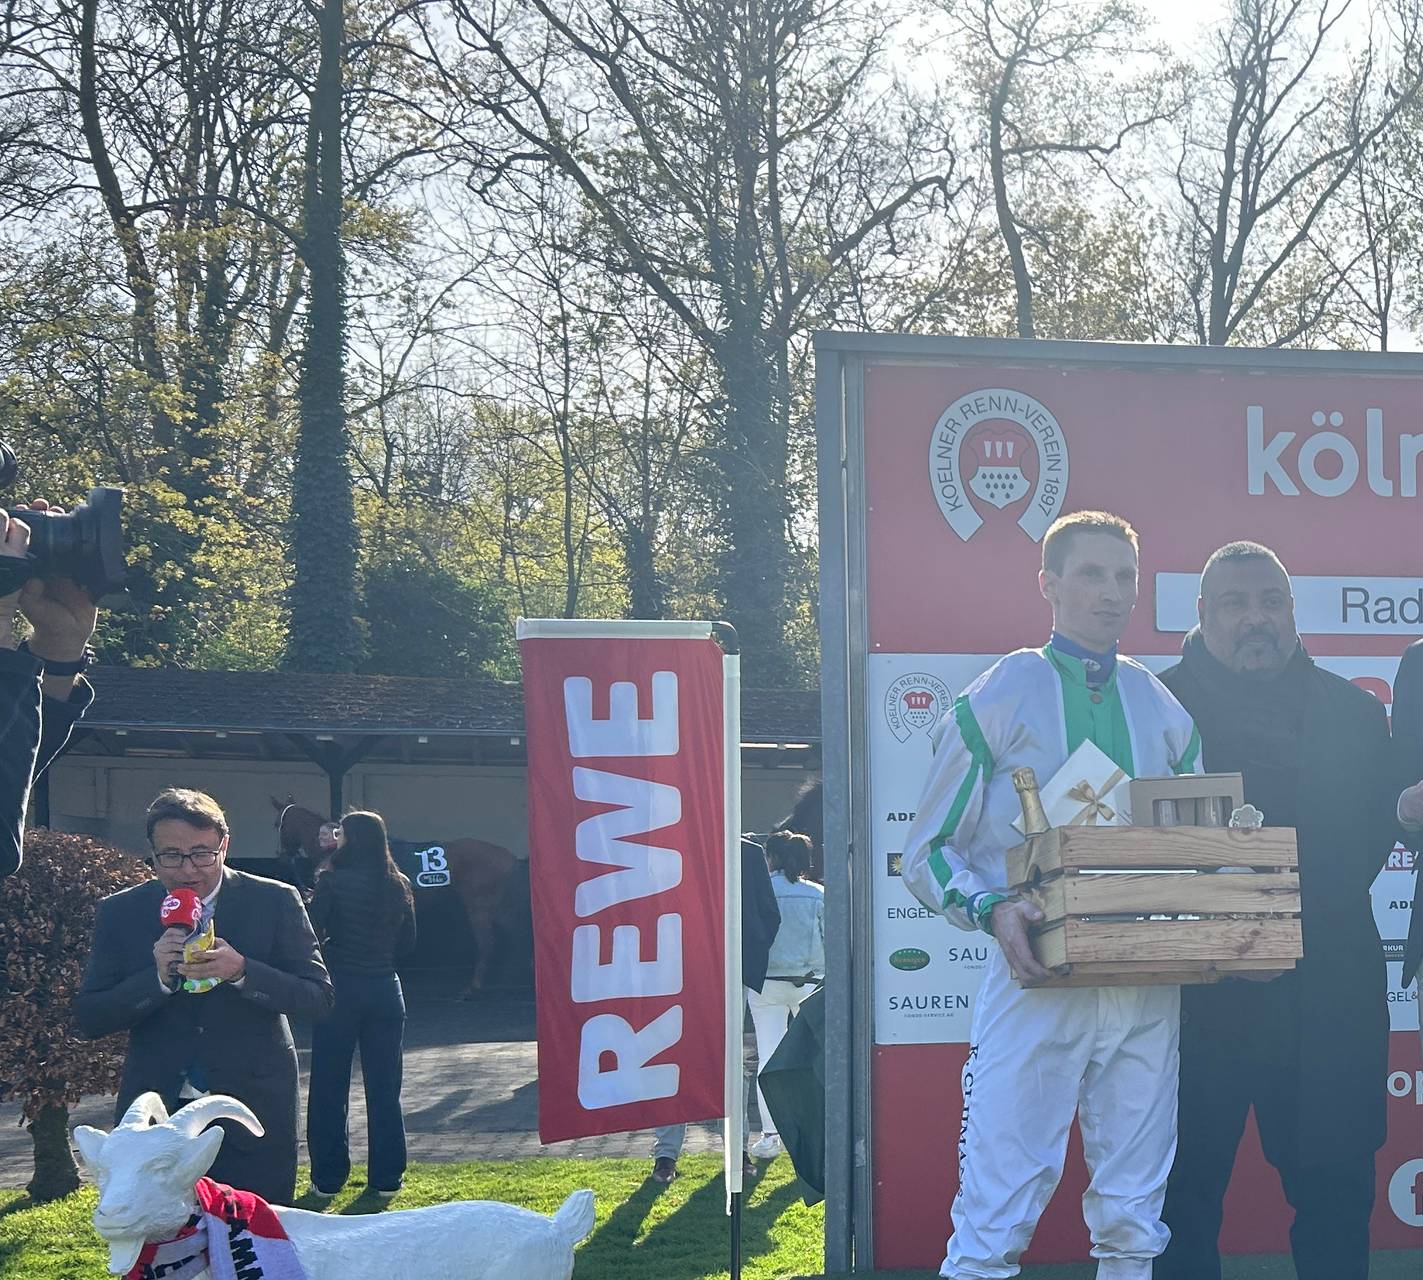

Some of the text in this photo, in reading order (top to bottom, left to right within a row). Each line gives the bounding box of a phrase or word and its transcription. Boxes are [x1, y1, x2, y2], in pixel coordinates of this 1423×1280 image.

[937, 396, 1062, 517] KOELNER RENN-VEREIN 1897
[414, 846, 448, 872] 13
[1388, 851, 1419, 868] RE
[563, 670, 683, 1111] REWE
[888, 994, 969, 1011] SAUREN
